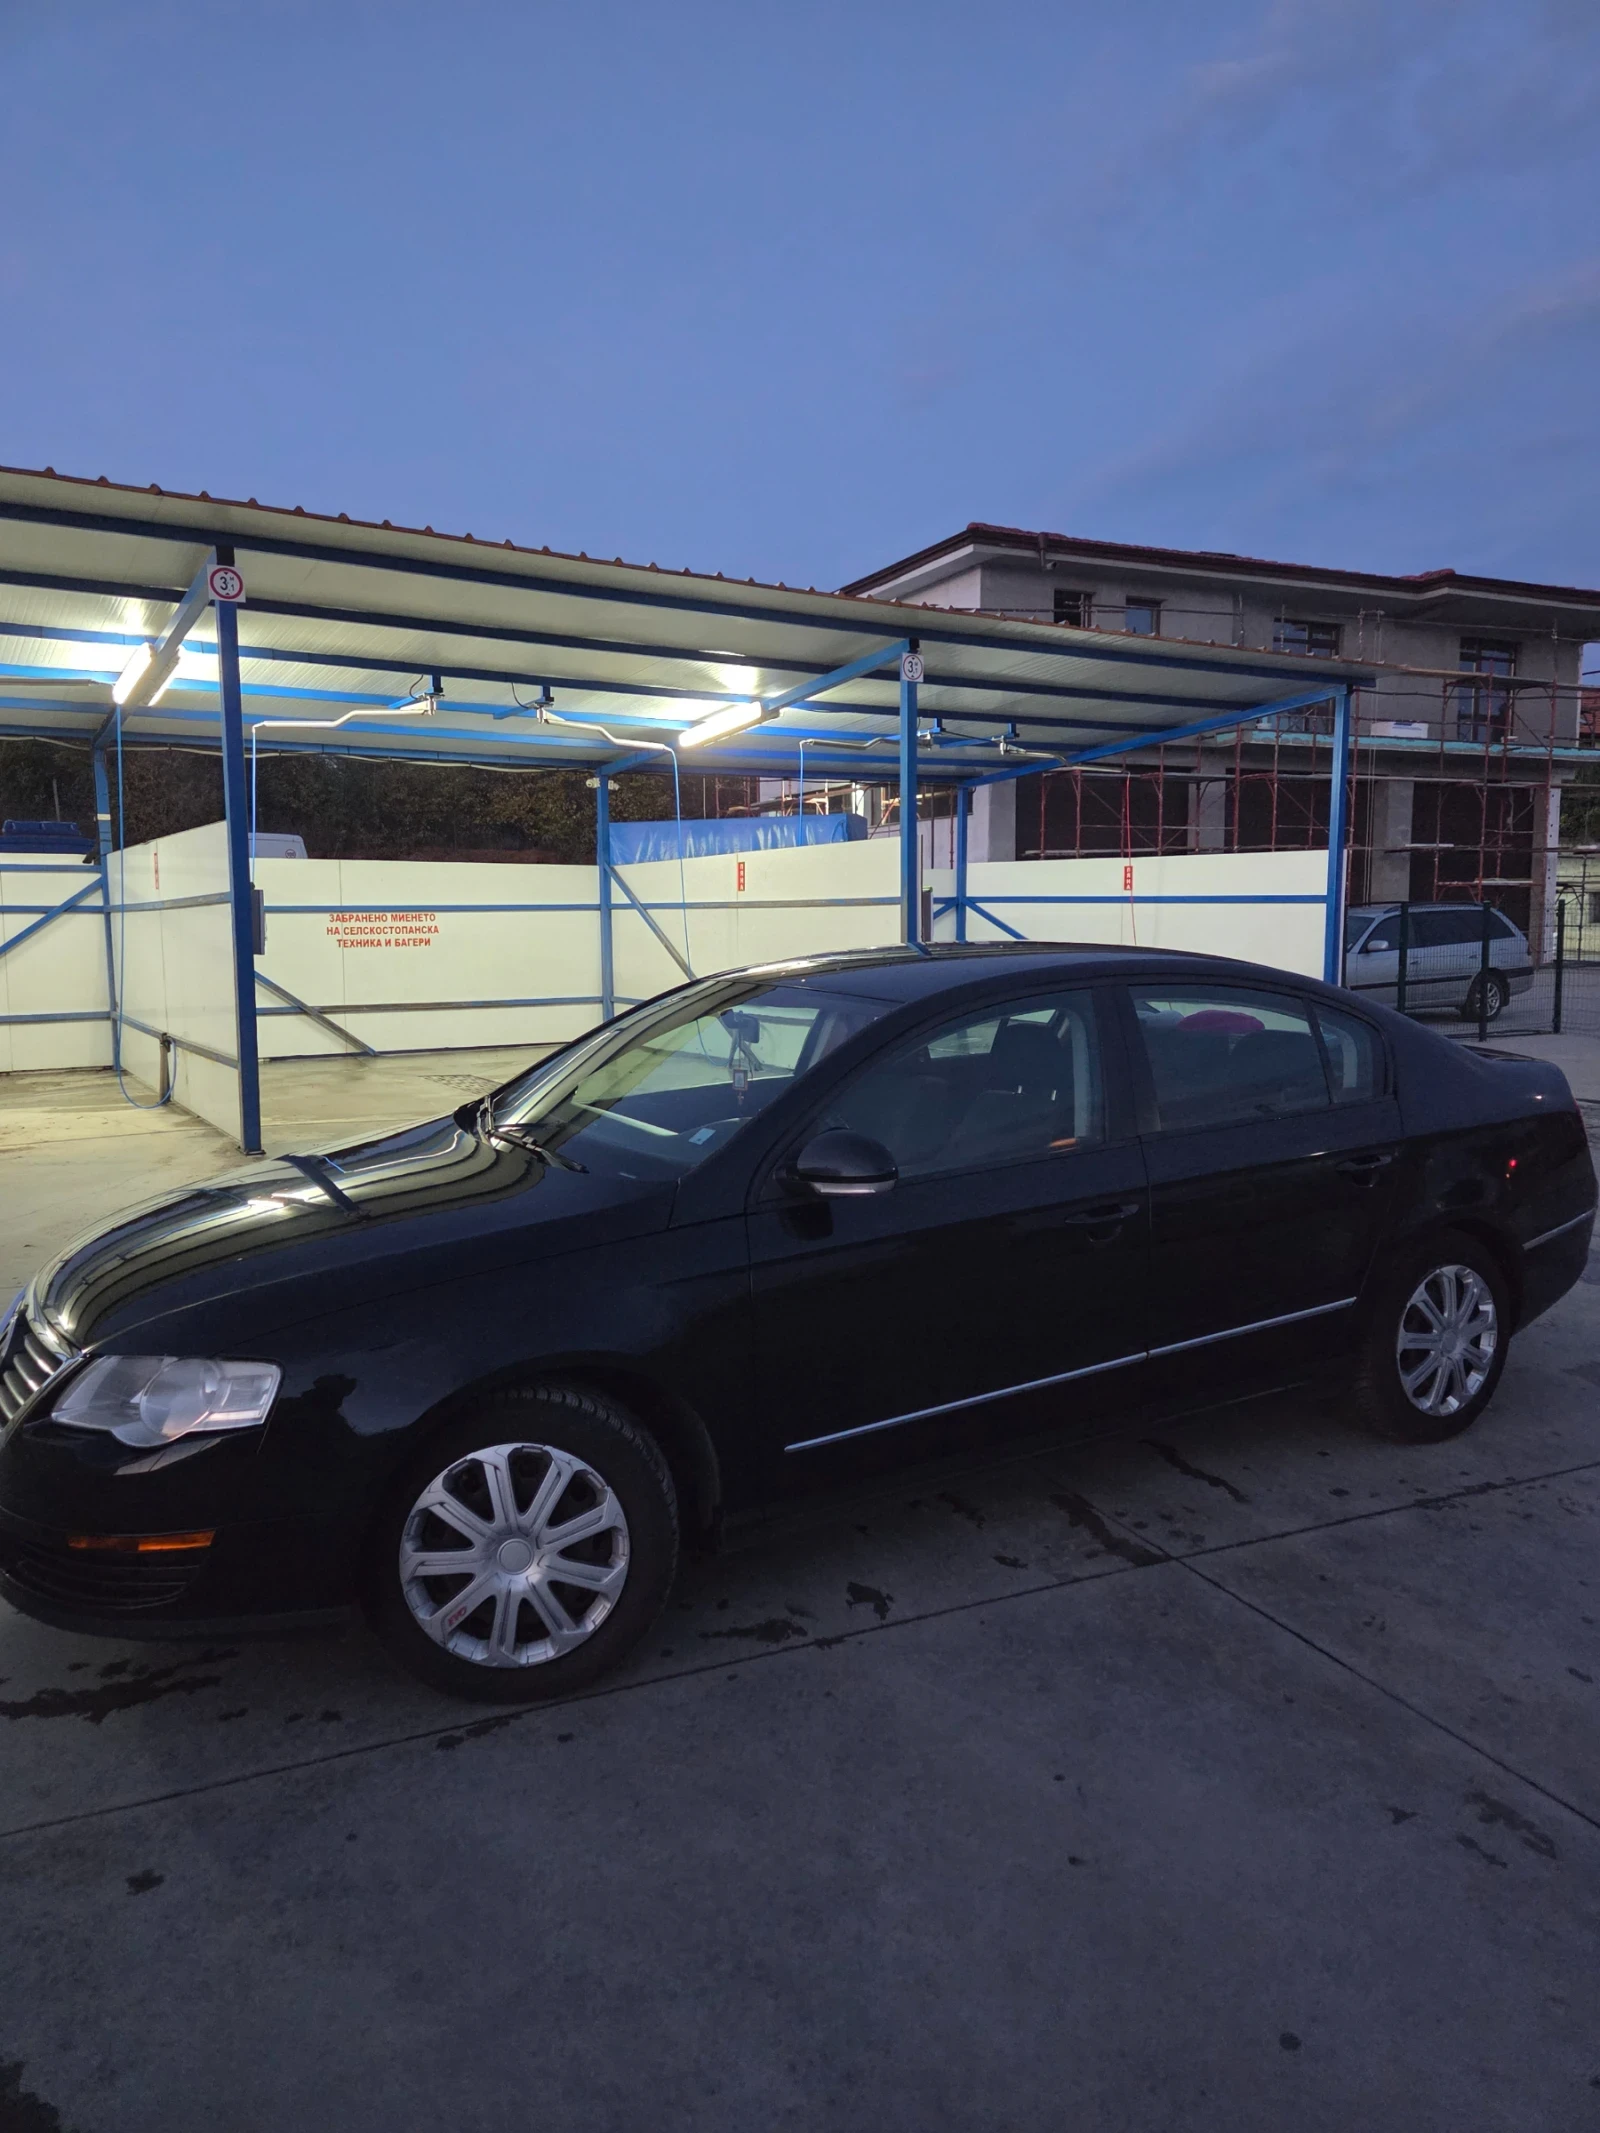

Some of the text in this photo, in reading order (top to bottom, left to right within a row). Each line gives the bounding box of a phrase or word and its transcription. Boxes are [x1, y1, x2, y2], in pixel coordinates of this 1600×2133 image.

[329, 913, 436, 923] ЗАБРАНЕНО МИЕНЕТО
[326, 925, 439, 935] НА СЕЛСКОСТОПАНСКА
[336, 938, 431, 948] ТЕХНИКА И БАГЕРИ
